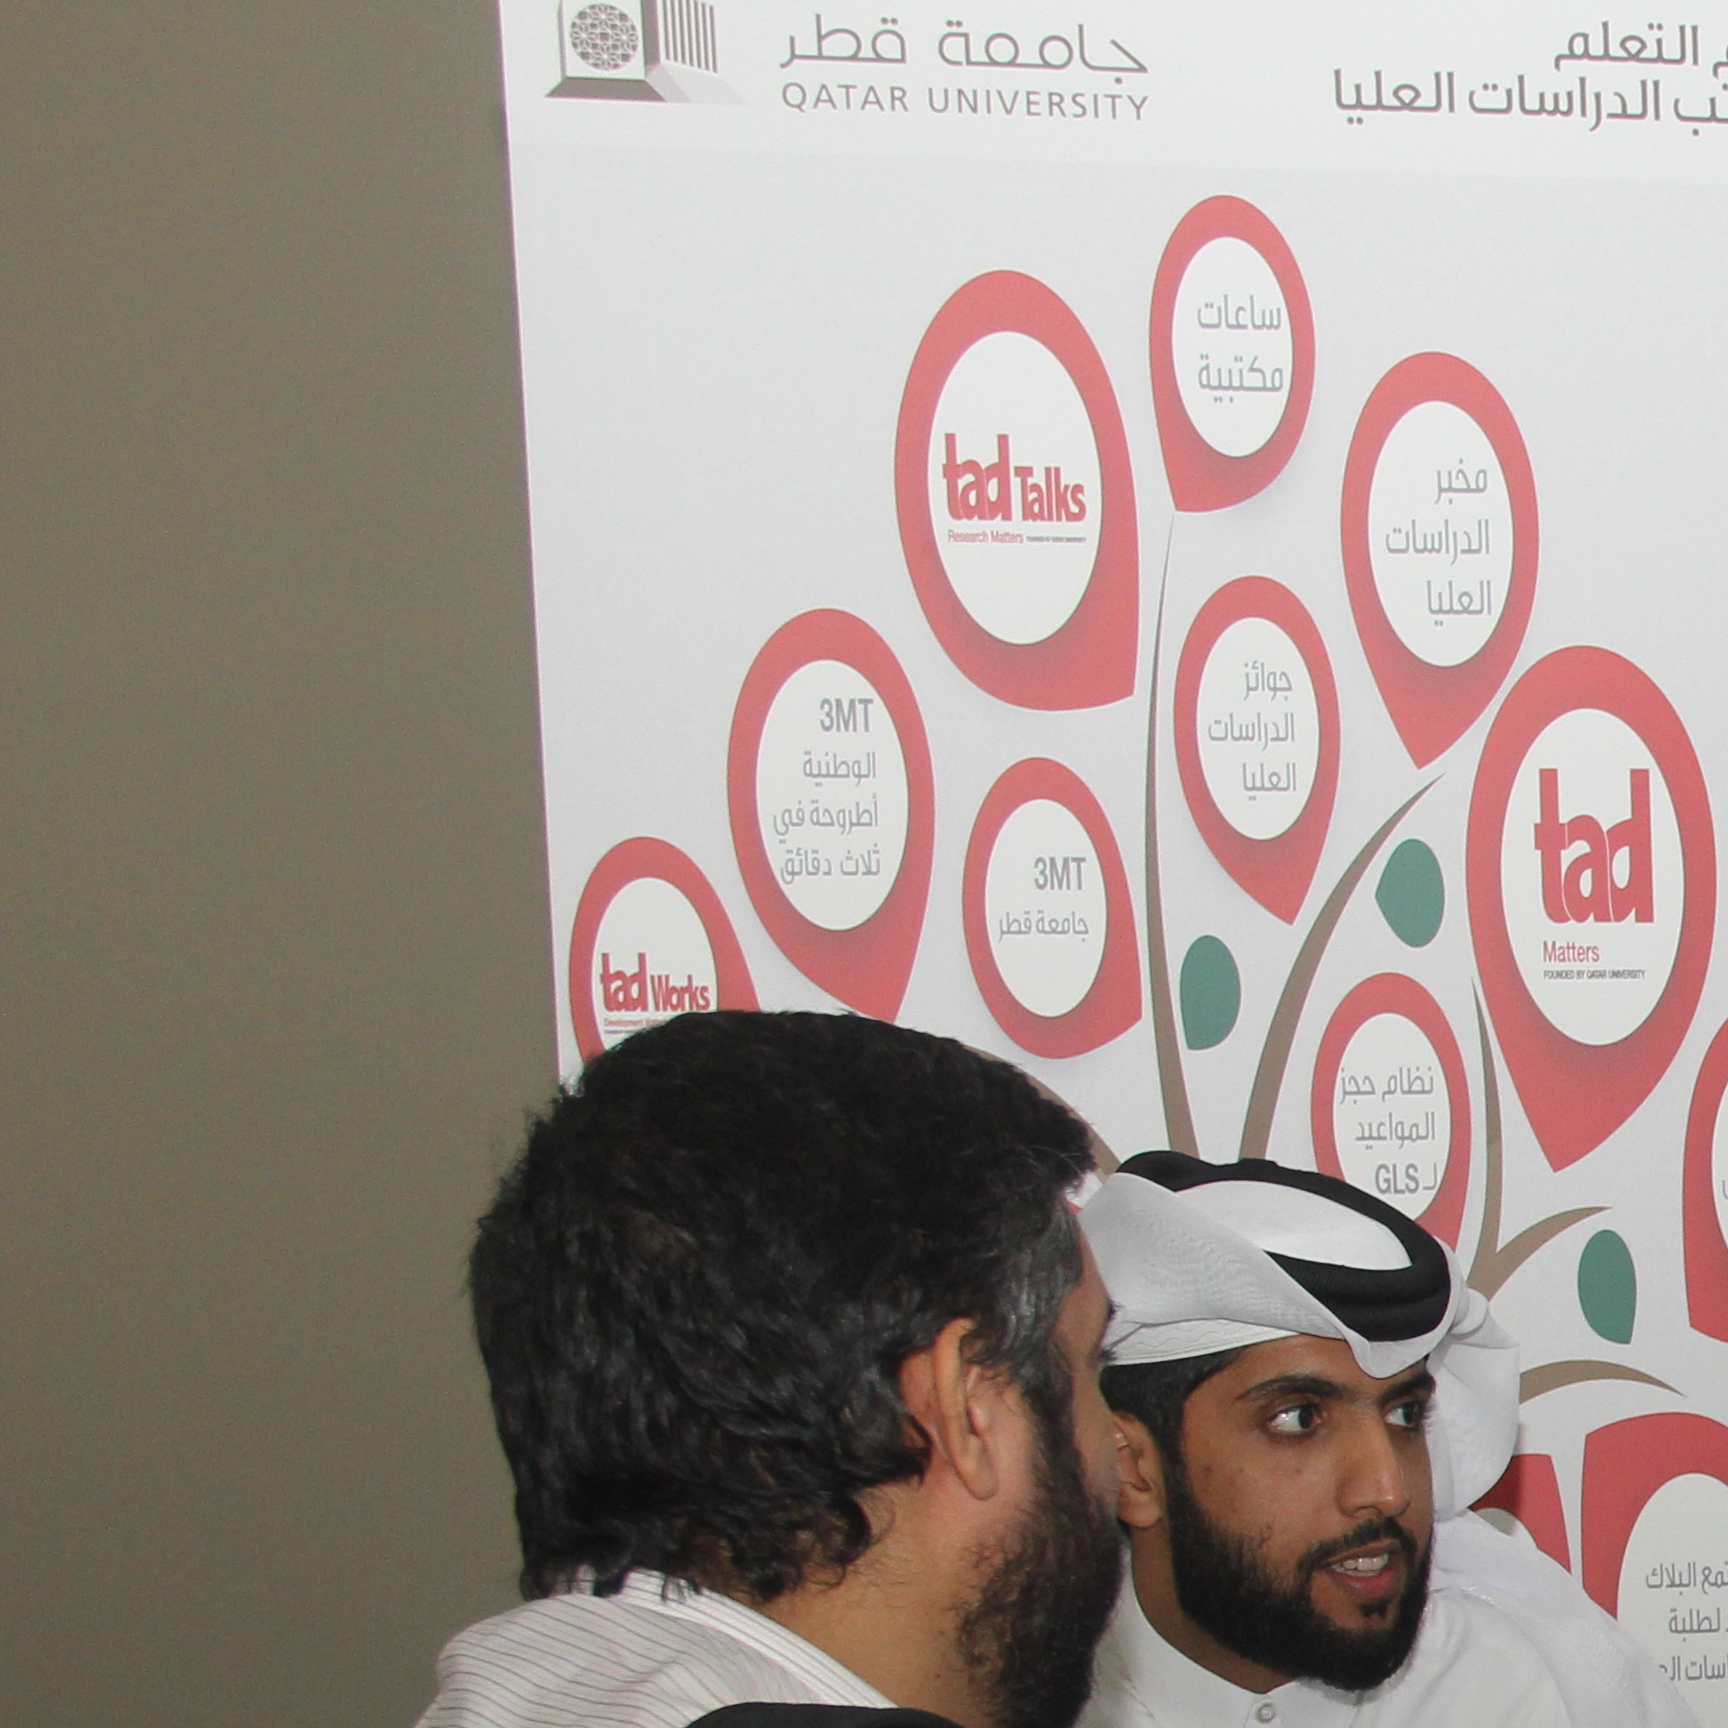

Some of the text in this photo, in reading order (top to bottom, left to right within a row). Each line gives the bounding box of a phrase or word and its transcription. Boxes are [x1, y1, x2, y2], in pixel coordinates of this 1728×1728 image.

[779, 14, 1149, 84] جامعة قطر
[1553, 21, 1700, 73] التعلم
[781, 82, 1149, 122] QATAR UNIVERSITY
[1333, 68, 1455, 126] العليا
[1468, 75, 1661, 131] الدراسات
[1198, 295, 1282, 332] ساعات
[1198, 356, 1284, 404] مكتبية
[942, 433, 1087, 523] tad Talks
[1434, 458, 1488, 505] مخبر
[1385, 519, 1490, 565] الدراسات
[1426, 580, 1493, 627] العليا
[1242, 660, 1294, 702] جوائز
[818, 698, 874, 734] 3MT
[1207, 711, 1296, 750] الدراسات
[803, 751, 877, 788] الوطنية
[1240, 762, 1298, 801] العليا
[772, 794, 879, 845] أطروحة في
[779, 844, 881, 886] ثلاث دقائق
[1533, 767, 1655, 925] tad
[1033, 856, 1087, 892] 3MT
[997, 909, 1089, 944] جامعة قطر
[1542, 940, 1600, 964] Matters
[600, 952, 712, 1012] tad Works
[1339, 1067, 1434, 1105] نظام حجز
[1354, 1112, 1436, 1151] المواعيد
[1374, 1162, 1420, 1195] GLS
[1645, 1561, 1697, 1597] البلاك
[1668, 1606, 1722, 1642] لطلبة
